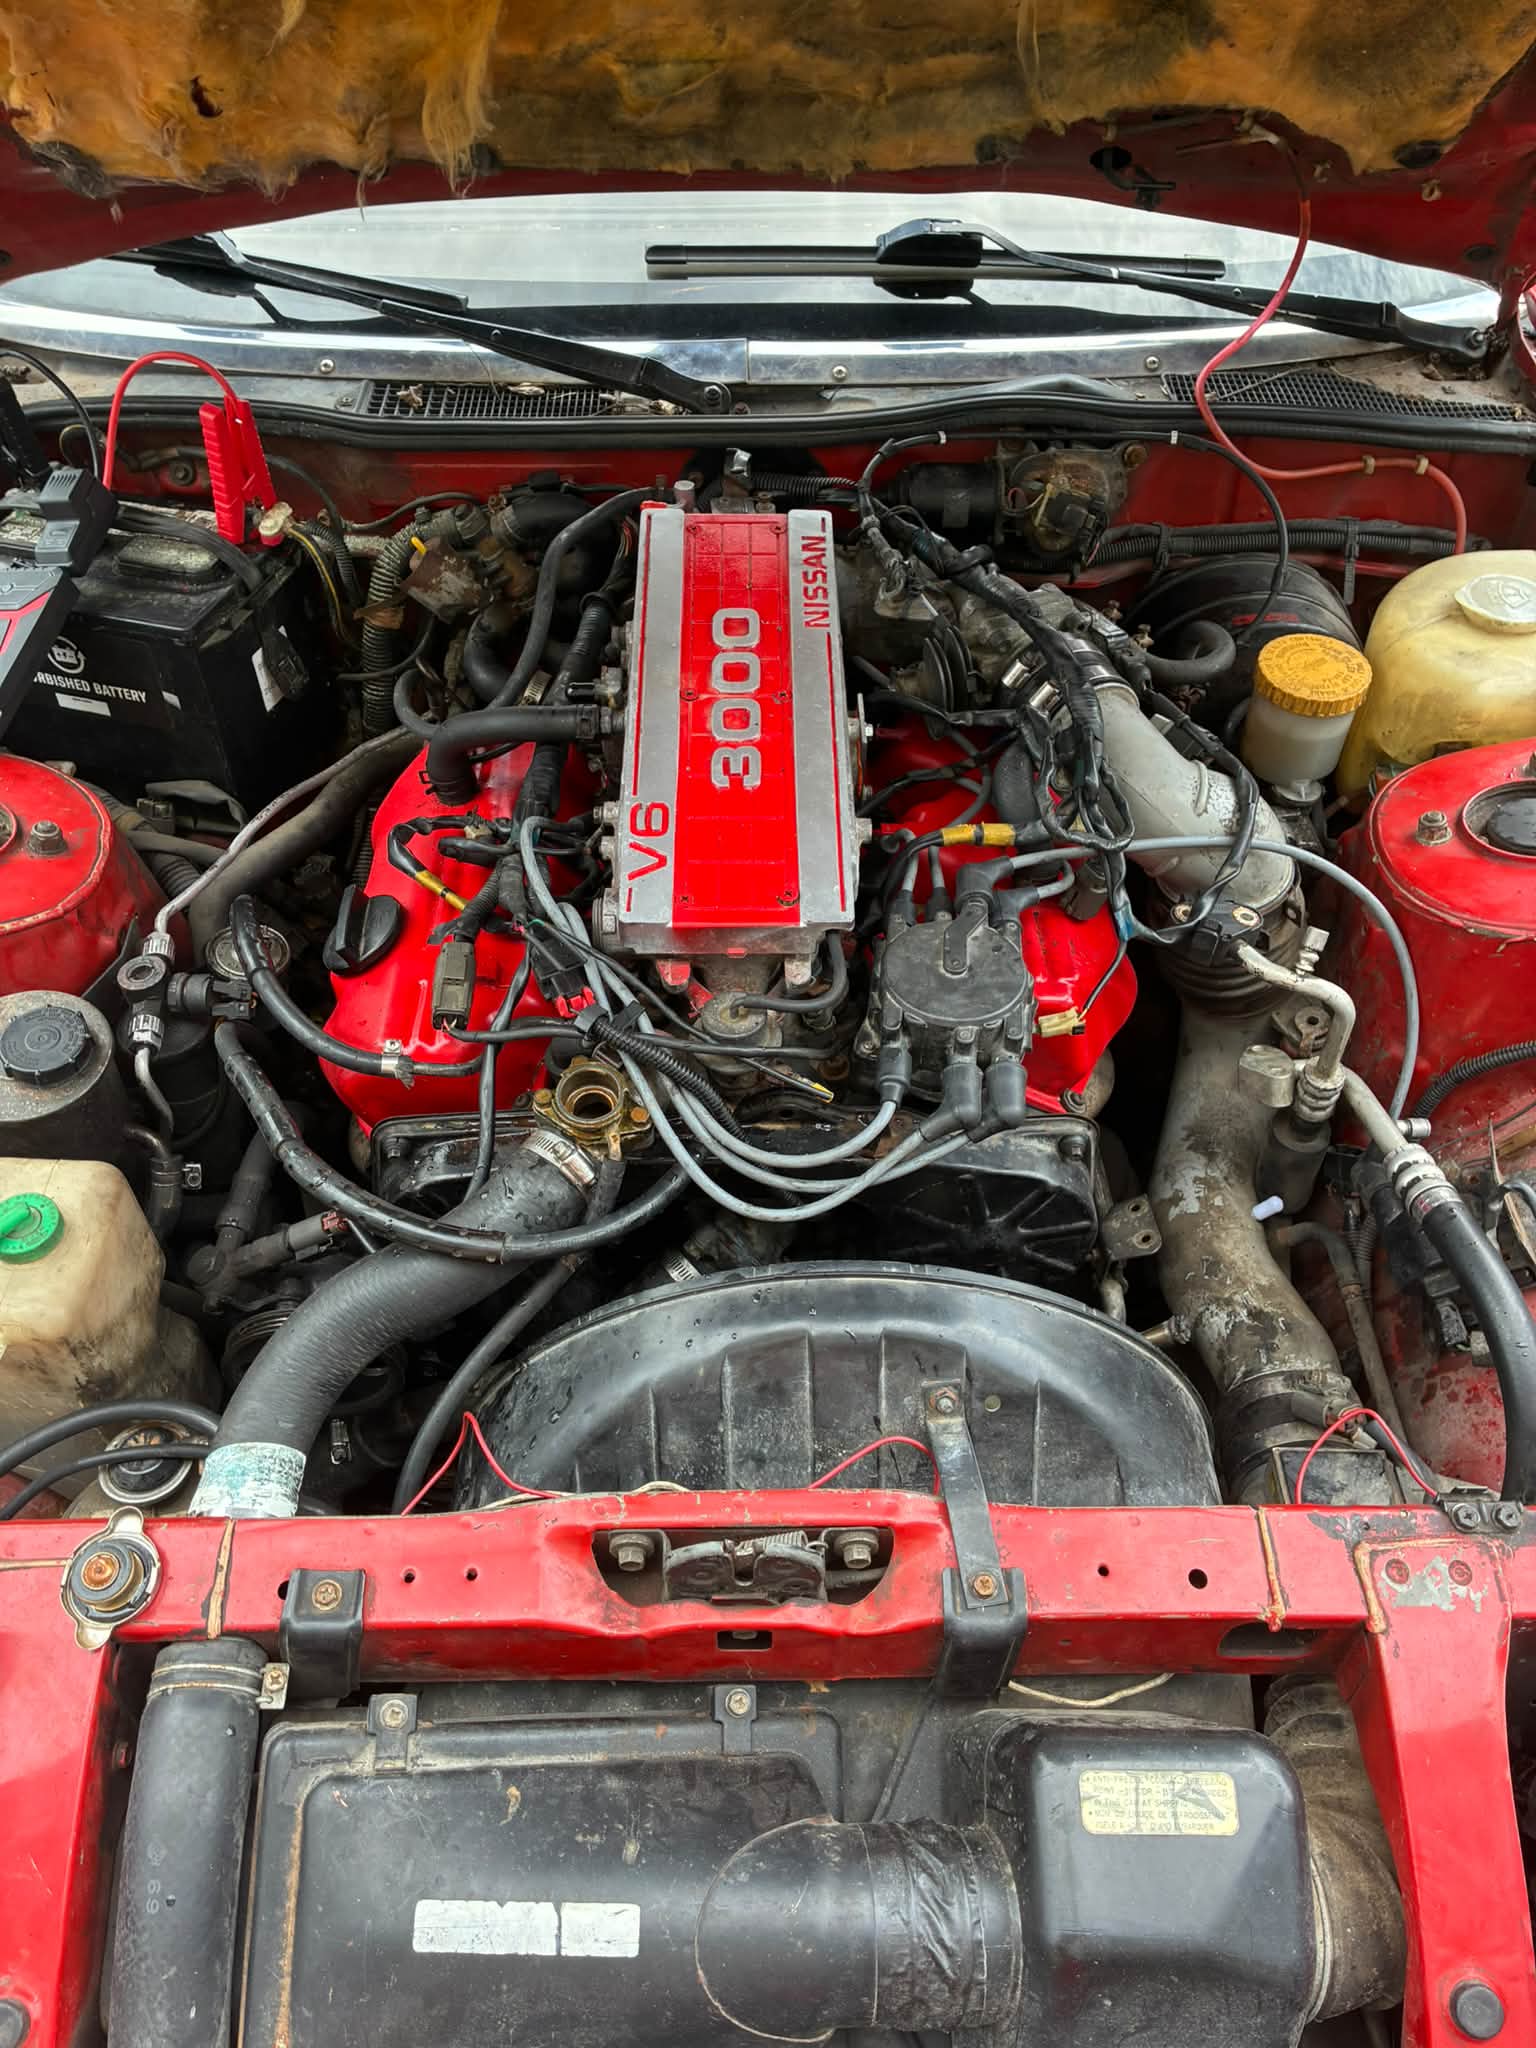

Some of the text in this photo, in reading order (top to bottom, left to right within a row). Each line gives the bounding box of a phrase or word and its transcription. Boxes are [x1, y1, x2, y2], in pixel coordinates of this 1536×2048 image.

[801, 536, 831, 629] NISSAN
[33, 671, 147, 703] RBISHED BATTERY
[711, 607, 762, 791] 3000
[628, 801, 670, 881] V6
